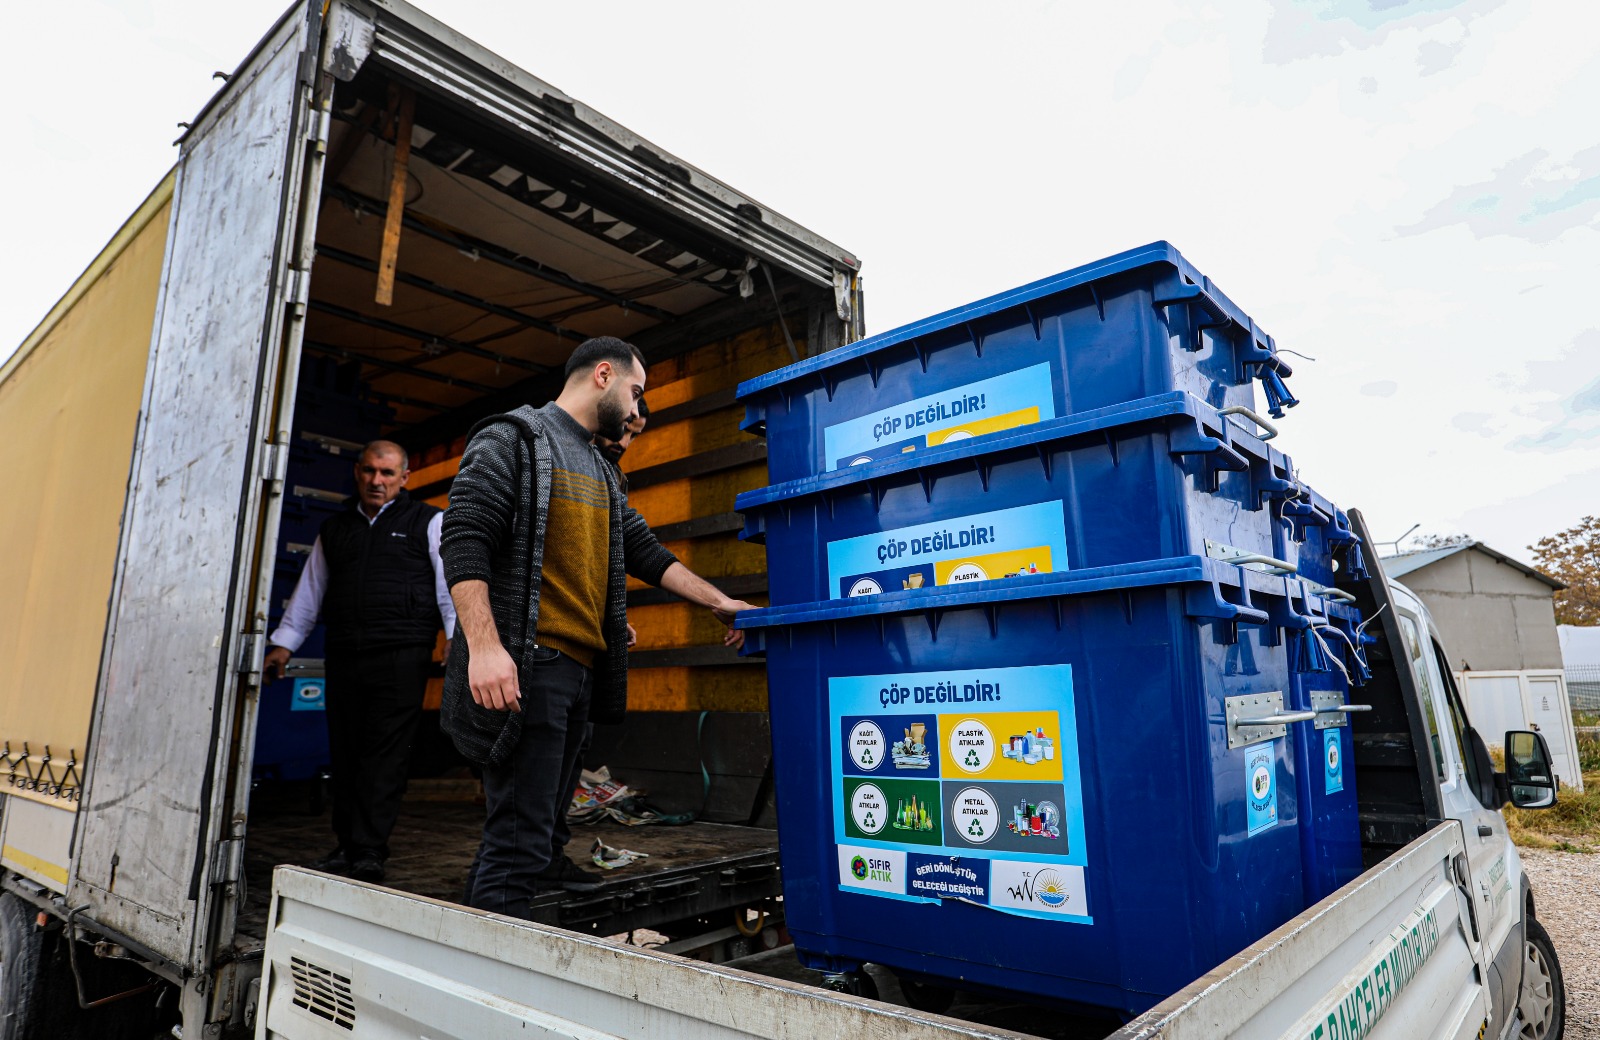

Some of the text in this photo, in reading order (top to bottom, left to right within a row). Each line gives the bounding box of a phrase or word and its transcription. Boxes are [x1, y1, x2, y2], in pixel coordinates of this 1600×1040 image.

[873, 393, 987, 442] ÇÖP DEĞİLDİR!
[877, 524, 996, 565] ÇÖP DEĞİLDİR!
[954, 571, 980, 582] PLASTİK
[879, 679, 1002, 709] ÇÖP DEĞİLDİR!
[957, 728, 985, 737] PLASTİK
[856, 738, 878, 746] ATIKLAR
[958, 738, 985, 747] ATIKLAR
[858, 802, 880, 810] ATIKLAR
[964, 798, 985, 806] METAL
[961, 807, 989, 816] ATIKLAR
[869, 858, 891, 872] SIFIR
[916, 862, 933, 876] GERİ
[870, 870, 893, 883] ATIK
[912, 880, 984, 896] GELECEĞİ DEĞİŞTİR
